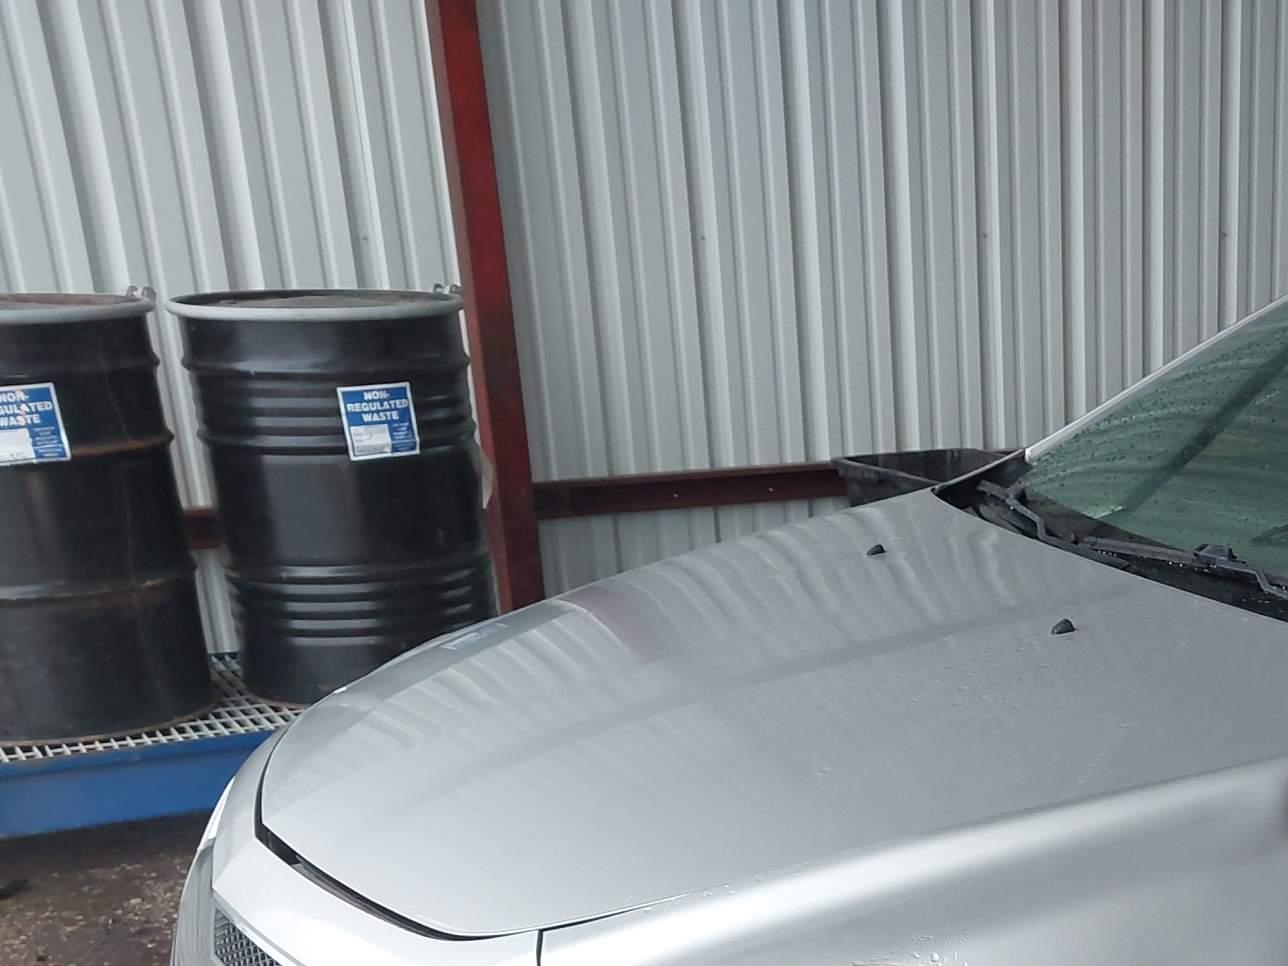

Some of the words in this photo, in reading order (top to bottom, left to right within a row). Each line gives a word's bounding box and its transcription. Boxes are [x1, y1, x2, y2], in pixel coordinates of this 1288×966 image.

[363, 390, 391, 401] NON-
[346, 399, 409, 412] REGULATED
[361, 410, 400, 422] WASTE
